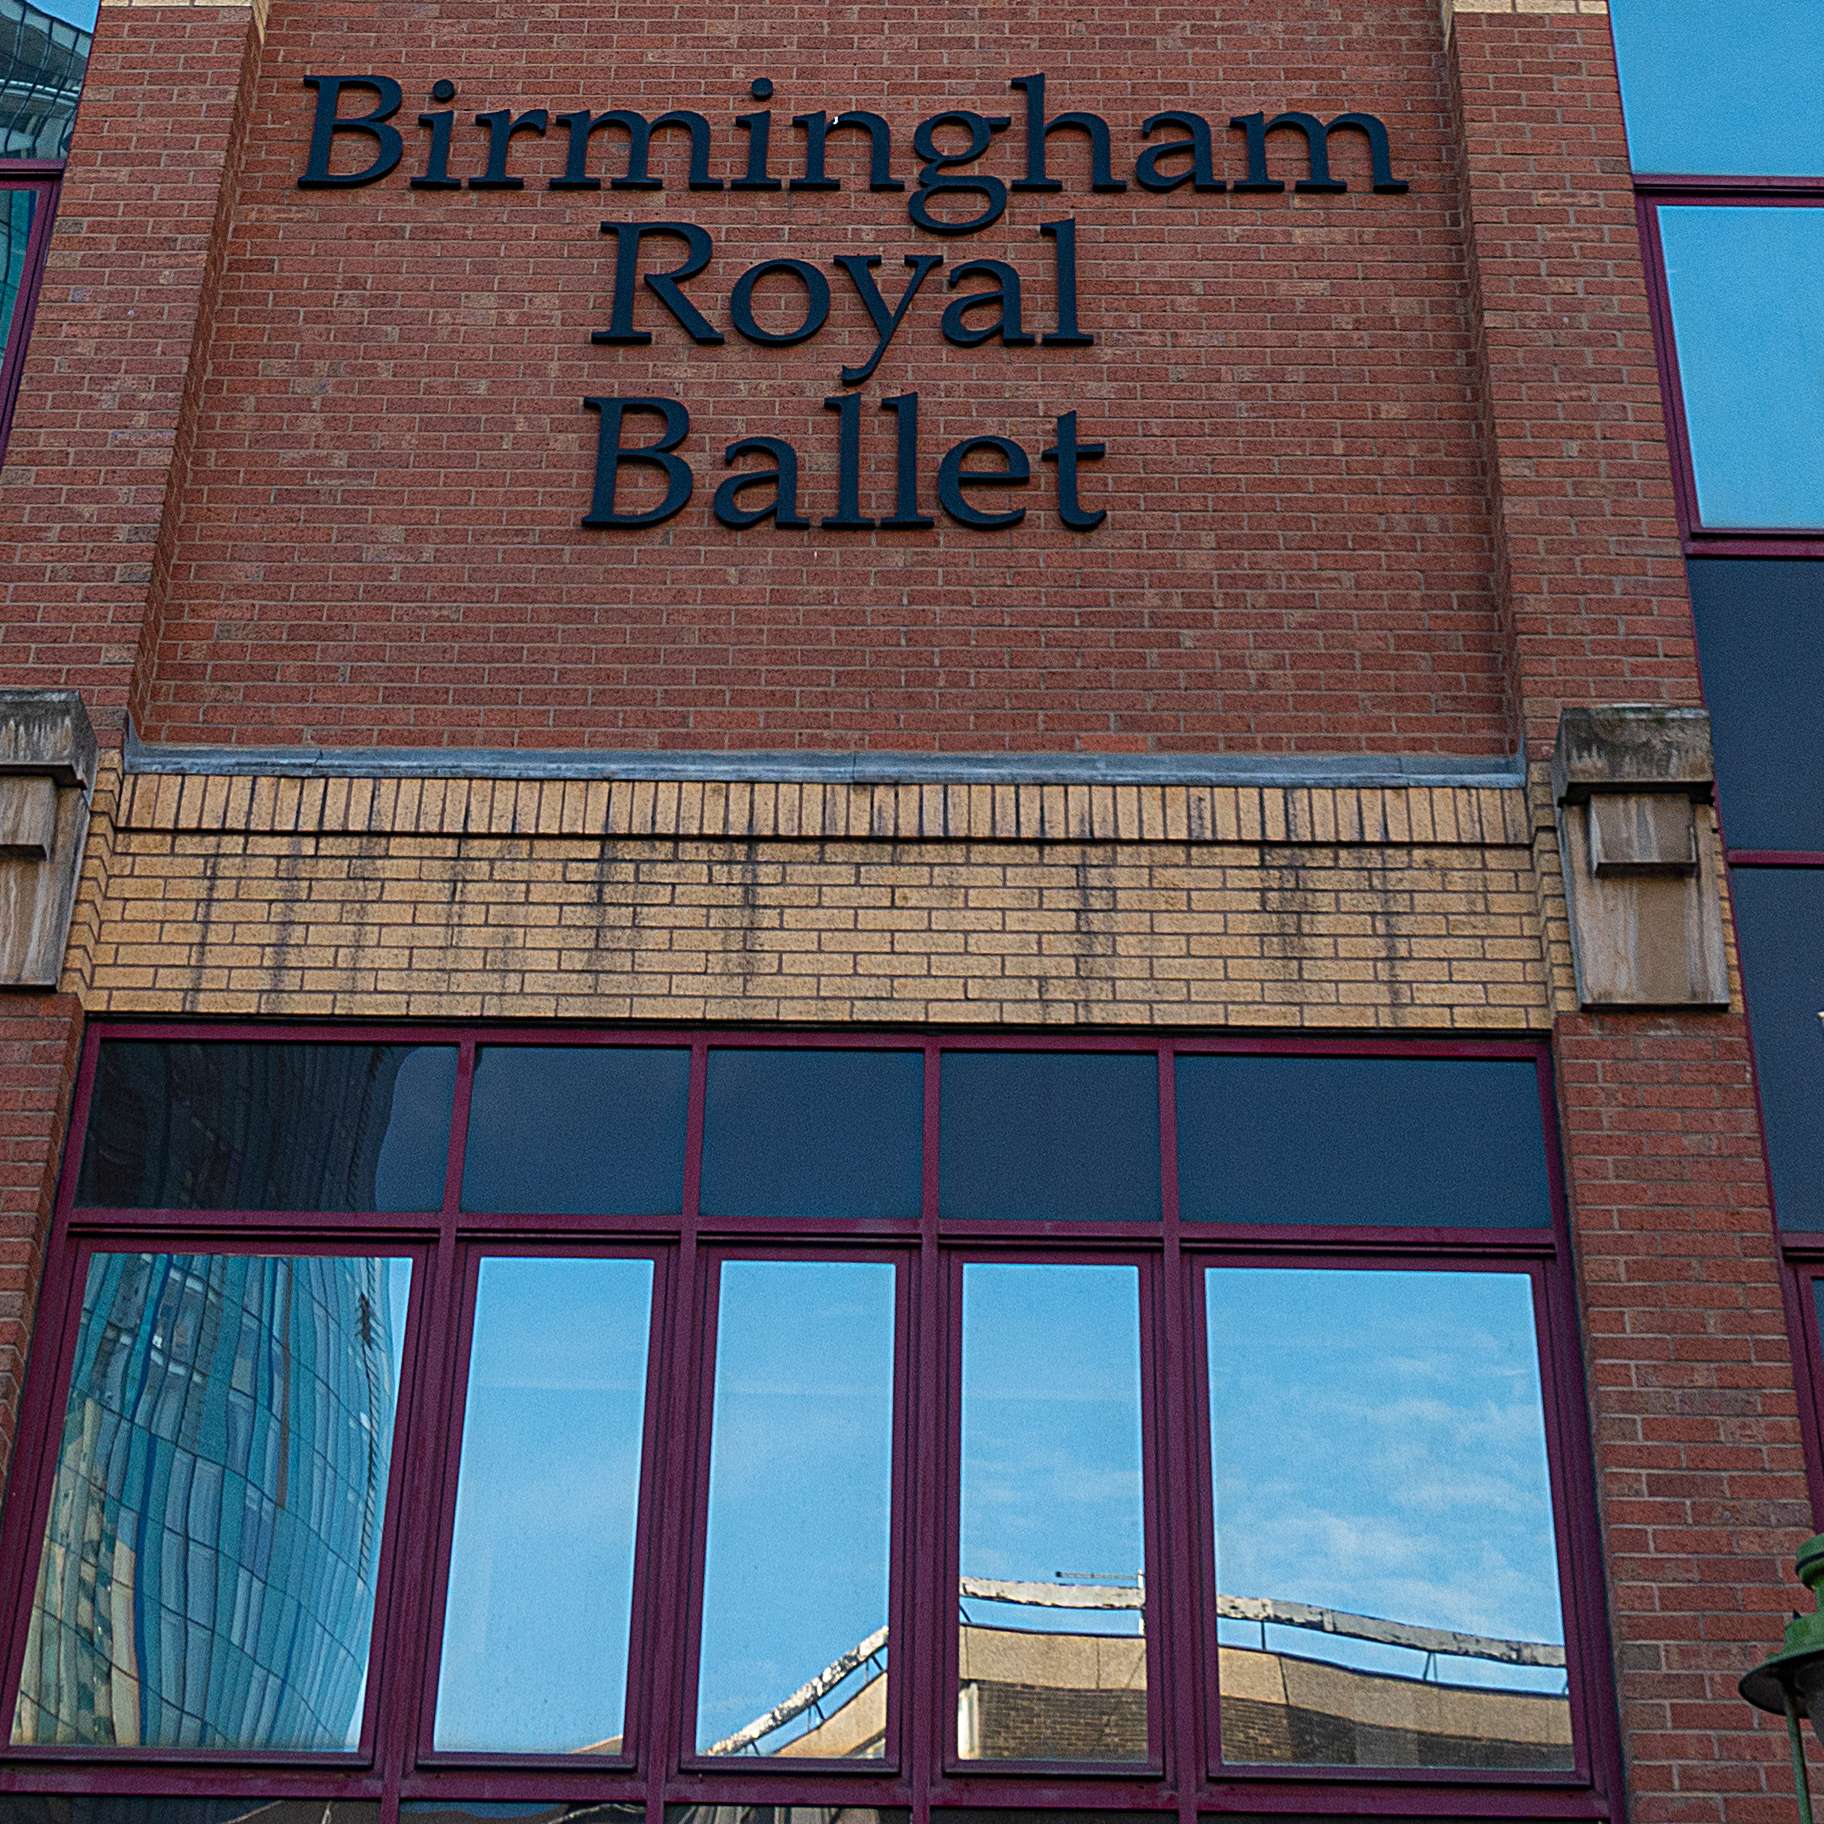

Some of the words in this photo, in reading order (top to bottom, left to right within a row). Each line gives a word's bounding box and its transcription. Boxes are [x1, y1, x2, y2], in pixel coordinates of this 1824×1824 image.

[295, 71, 1411, 236] Birmingham
[590, 217, 1095, 385] Royal
[580, 390, 1108, 533] Ballet
